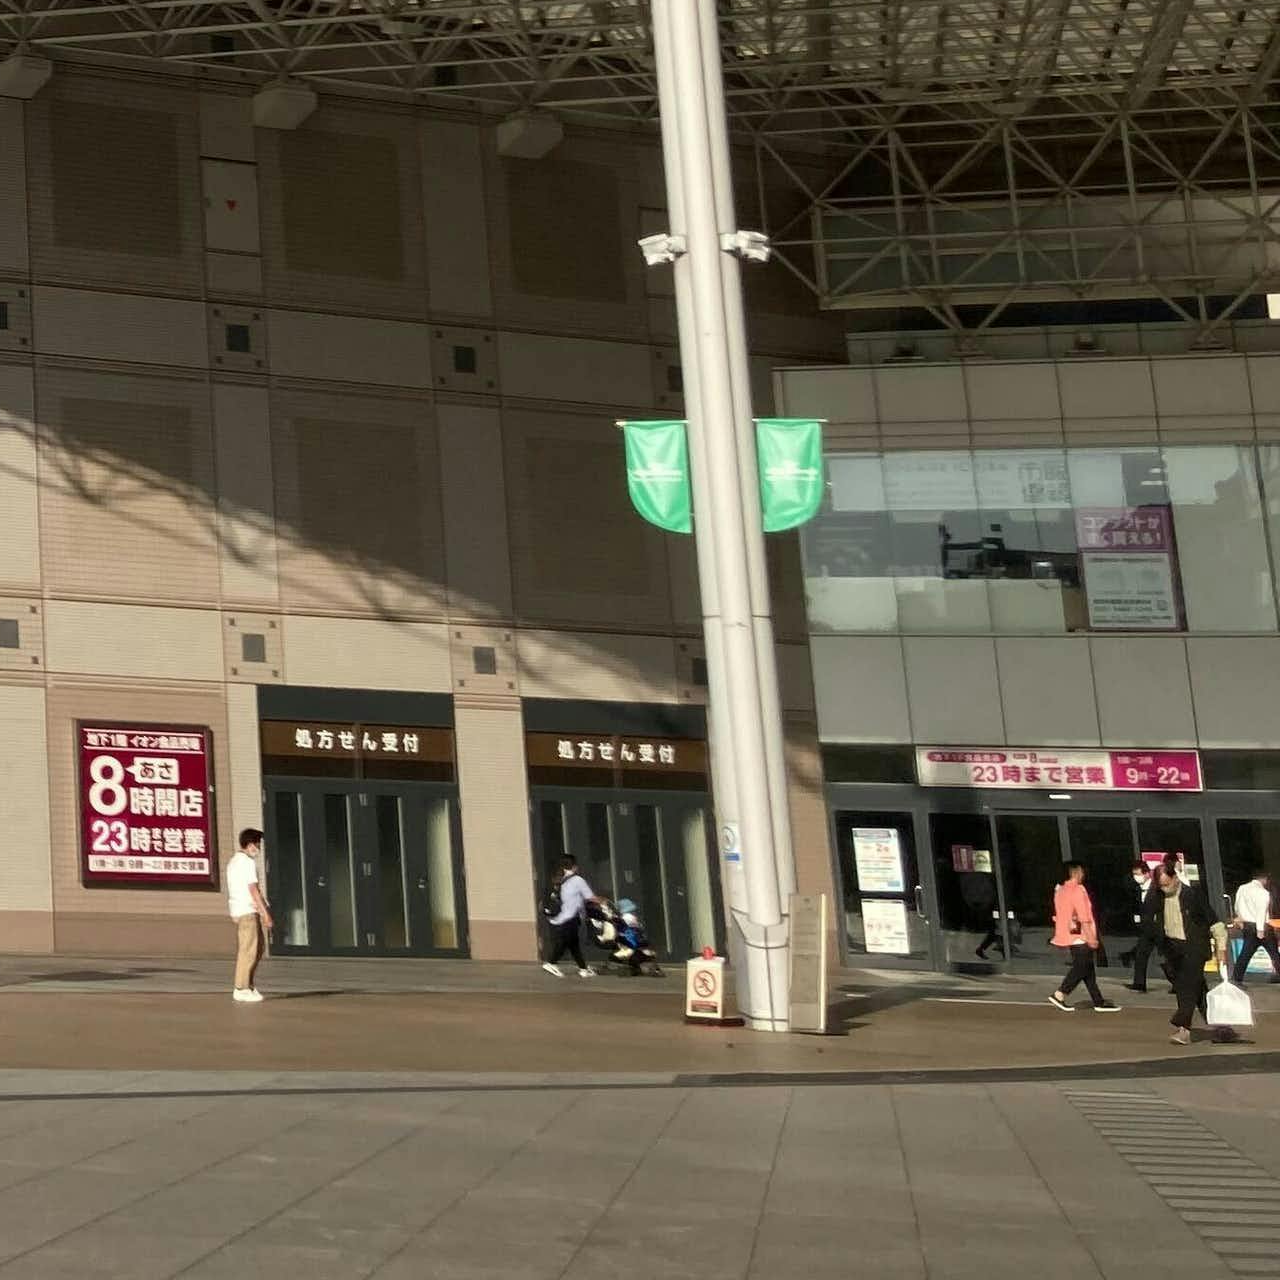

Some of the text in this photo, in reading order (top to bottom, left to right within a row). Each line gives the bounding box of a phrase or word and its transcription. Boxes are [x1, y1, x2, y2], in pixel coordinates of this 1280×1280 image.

[295, 728, 420, 754] 処方せん受付
[557, 740, 675, 765] 処方せん受付
[140, 762, 173, 780] あさ
[973, 765, 1107, 785] 23時まで営業
